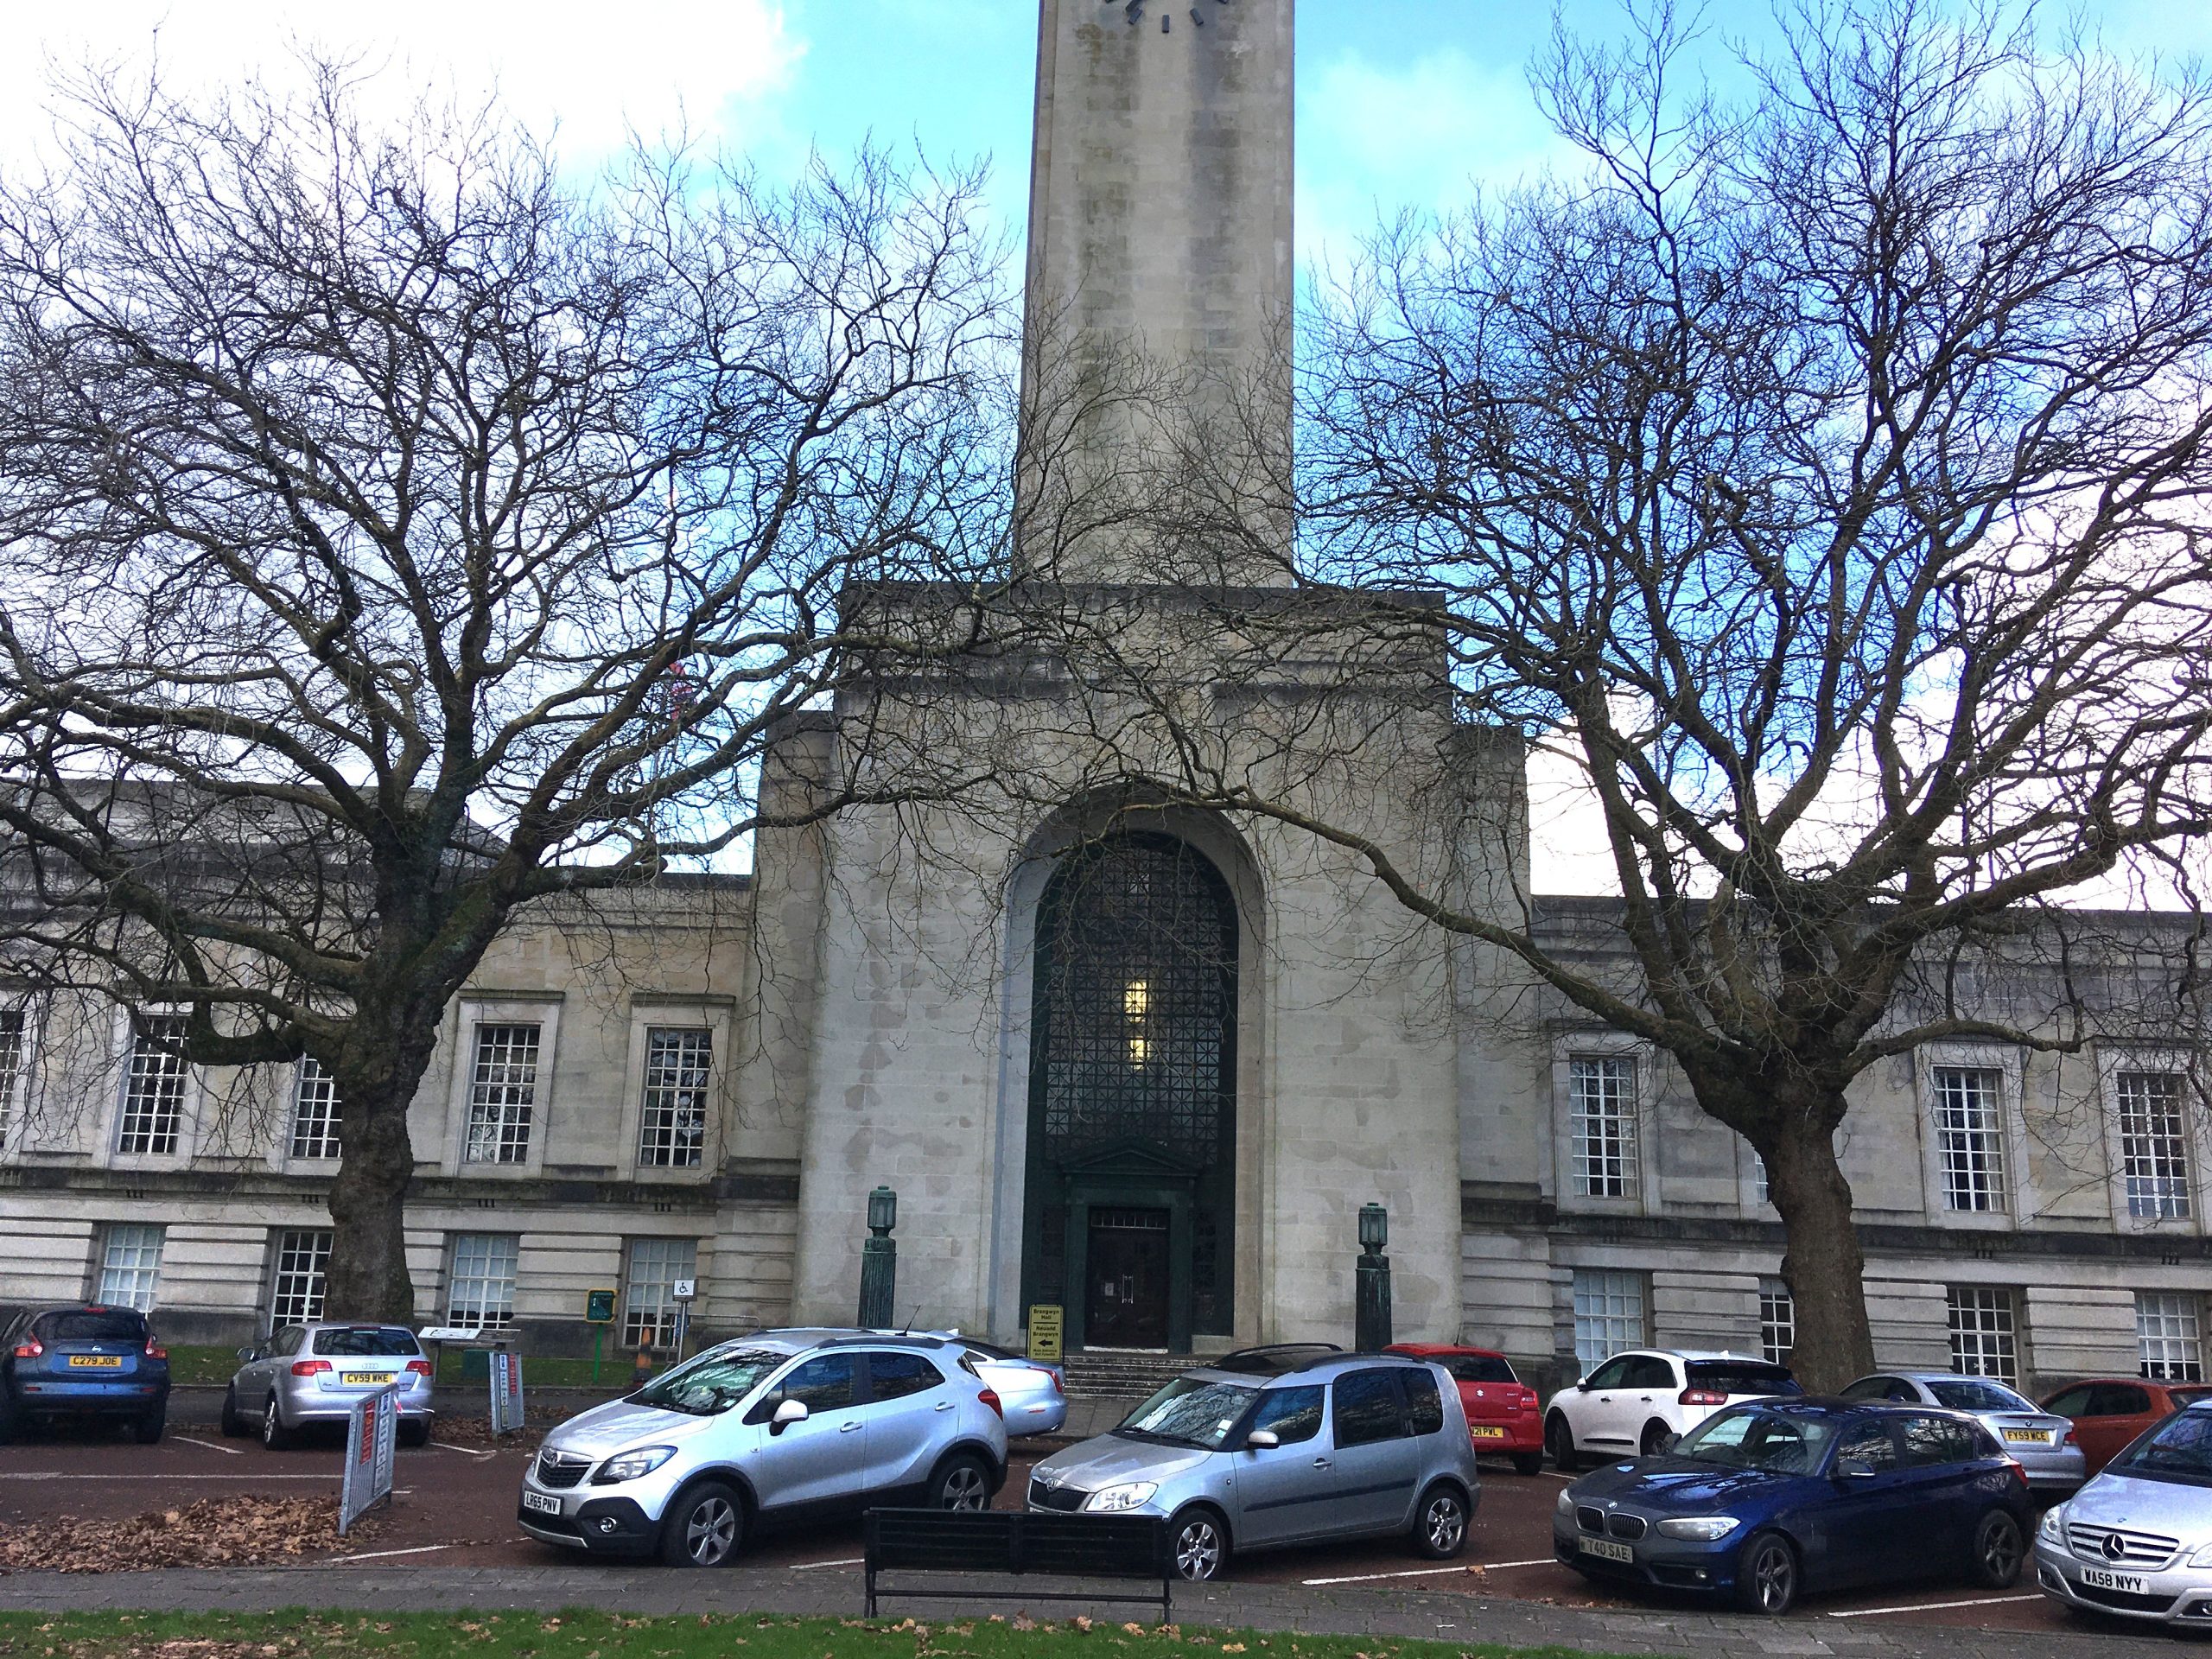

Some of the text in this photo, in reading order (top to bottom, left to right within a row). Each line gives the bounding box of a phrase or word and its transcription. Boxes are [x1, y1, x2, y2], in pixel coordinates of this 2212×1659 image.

[73, 1357, 118, 1365] C279 JOE
[347, 1374, 389, 1382] CV59 WKE
[1483, 1427, 1498, 1436] PWL
[2007, 1431, 2030, 1440] FY59
[526, 1493, 557, 1512] LR65 PNV
[1588, 1540, 1628, 1560] T40 SAE
[2084, 1569, 2142, 1592] WA58 NYY
